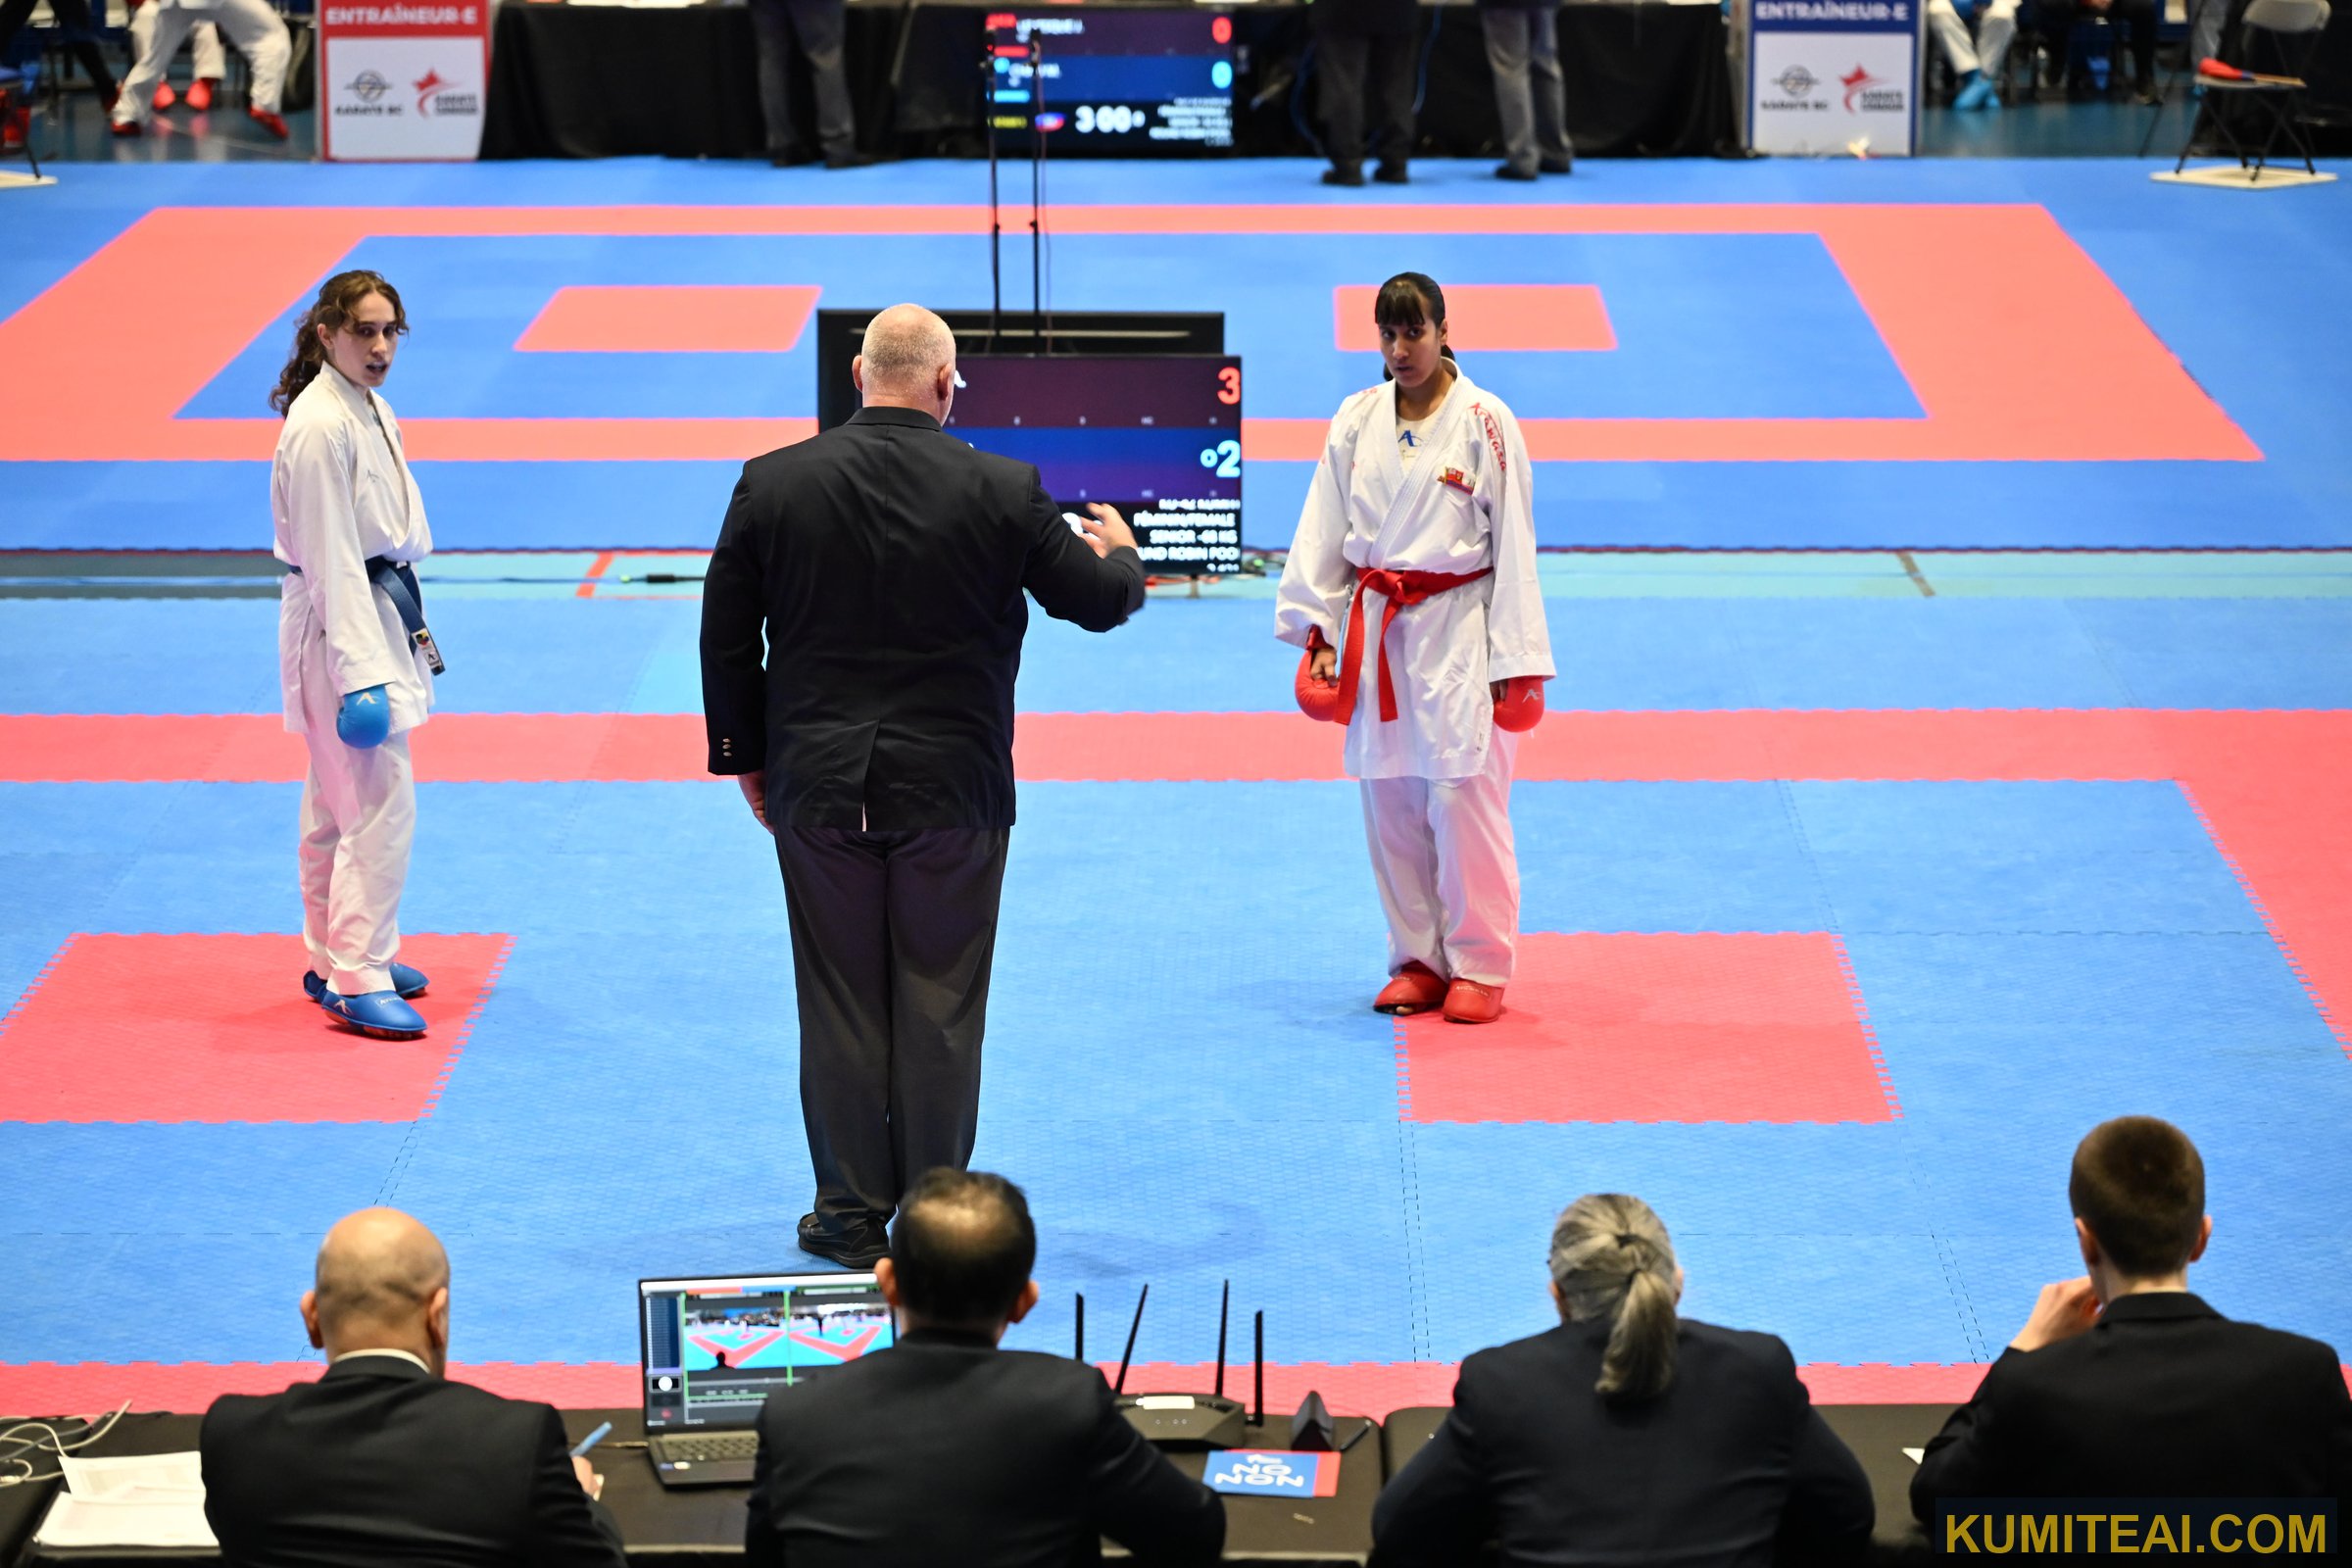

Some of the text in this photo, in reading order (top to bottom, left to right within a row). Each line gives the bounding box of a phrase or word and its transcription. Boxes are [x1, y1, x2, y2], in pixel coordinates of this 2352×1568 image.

[1216, 367, 1241, 405] 3
[1216, 439, 1241, 478] 2
[1150, 529, 1196, 544] SENIOR
